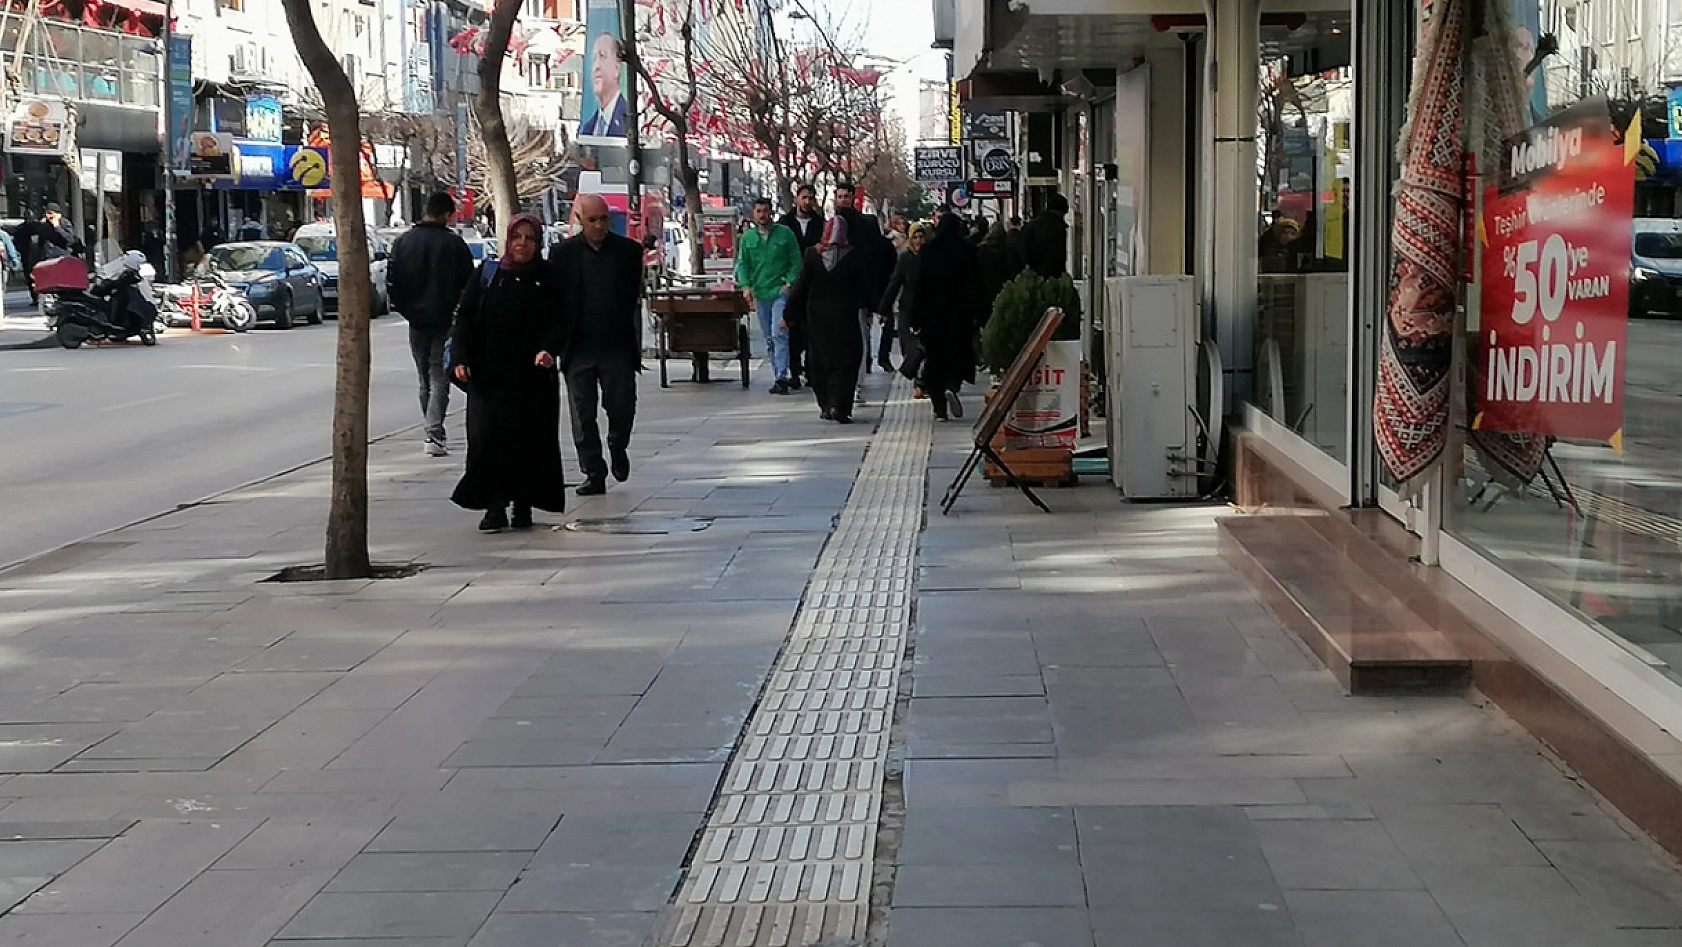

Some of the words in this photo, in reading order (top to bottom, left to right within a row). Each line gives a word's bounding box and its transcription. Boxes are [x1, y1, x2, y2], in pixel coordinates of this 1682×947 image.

[1511, 126, 1582, 178] Mobilya
[1493, 208, 1527, 238] Teşhir
[1567, 275, 1610, 302] VARAN
[1487, 321, 1617, 404] İNDİRİM
